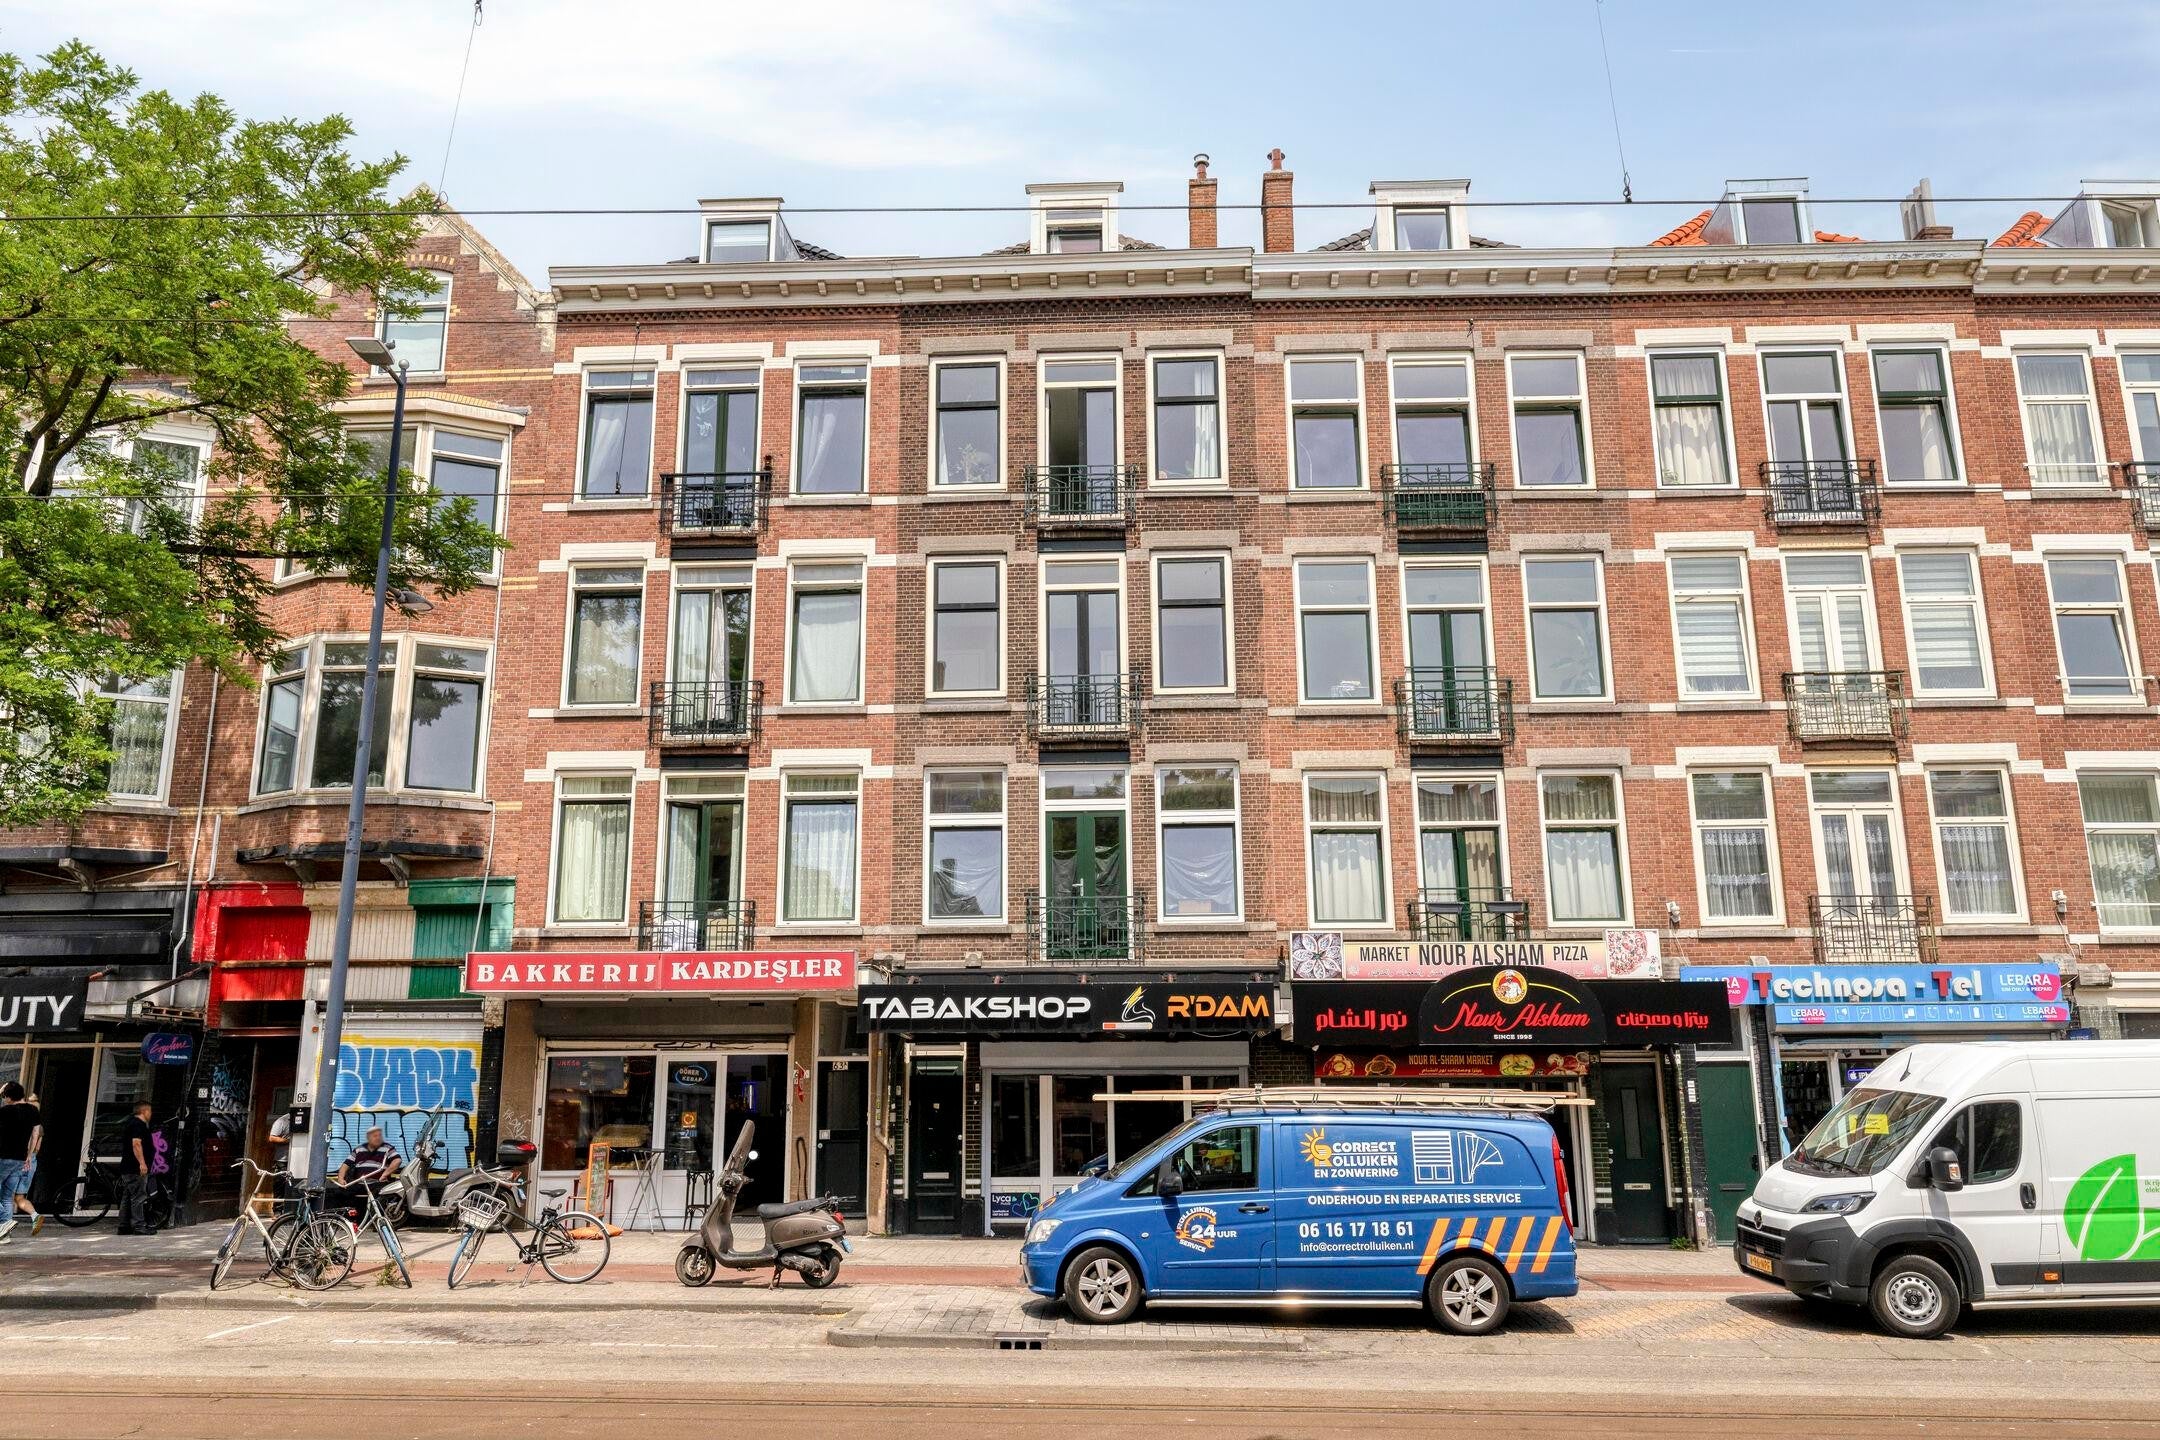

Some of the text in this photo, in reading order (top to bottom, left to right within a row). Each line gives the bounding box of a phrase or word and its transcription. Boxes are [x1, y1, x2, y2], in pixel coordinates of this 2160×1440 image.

[1360, 943, 1589, 966] MARKET NOUR ALSHAM PIZZA
[476, 958, 843, 983] BAKKERIJ KARDEŞLER
[1752, 970, 1908, 999] Technosa
[1931, 970, 1983, 998] Tel
[2000, 974, 2052, 986] LEBARA
[0, 995, 74, 1027] UTY
[862, 995, 1270, 1019] TABAKSHOP R'DAM
[1791, 1008, 1825, 1017] LEBARA
[2022, 1006, 2057, 1015] LEBARA
[1316, 1008, 1408, 1031] نور الشام
[1434, 1002, 1591, 1032] Nour Alsham
[1408, 1054, 1428, 1065] NOUR
[1466, 1054, 1493, 1065] MARKET
[679, 1066, 700, 1076] DÖNER
[296, 1092, 308, 1103] 65
[1332, 1141, 1397, 1154] CORRECT
[1314, 1167, 1398, 1178] EN ZONWERING
[992, 1194, 1011, 1204] Lyca
[1308, 1193, 1521, 1205] ONDERHOUD EN REPARATIES SERVICE
[1176, 1206, 1217, 1230] ROLLUIKEN
[1191, 1224, 1237, 1239] 24 UUR
[1299, 1221, 1413, 1238] 06 16 17 18 61
[1179, 1239, 1207, 1253] SERVICE
[1300, 1241, 1414, 1252] info@correctrolluiken.nl
